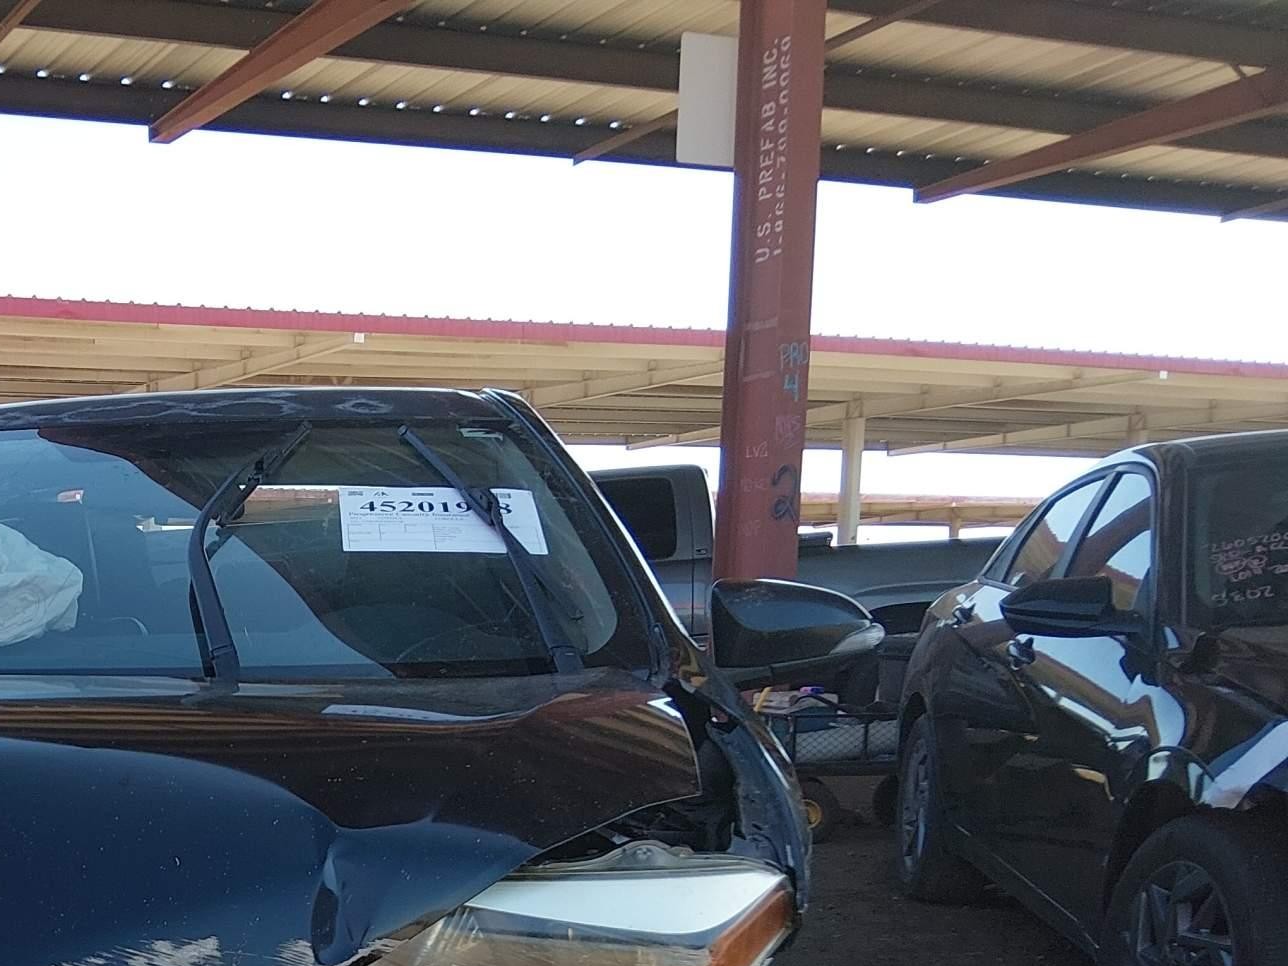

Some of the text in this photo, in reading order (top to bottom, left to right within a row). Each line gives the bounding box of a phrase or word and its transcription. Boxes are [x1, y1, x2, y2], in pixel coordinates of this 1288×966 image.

[755, 38, 779, 264] U.S. PREFAB INC.
[359, 500, 513, 515] 4520198
